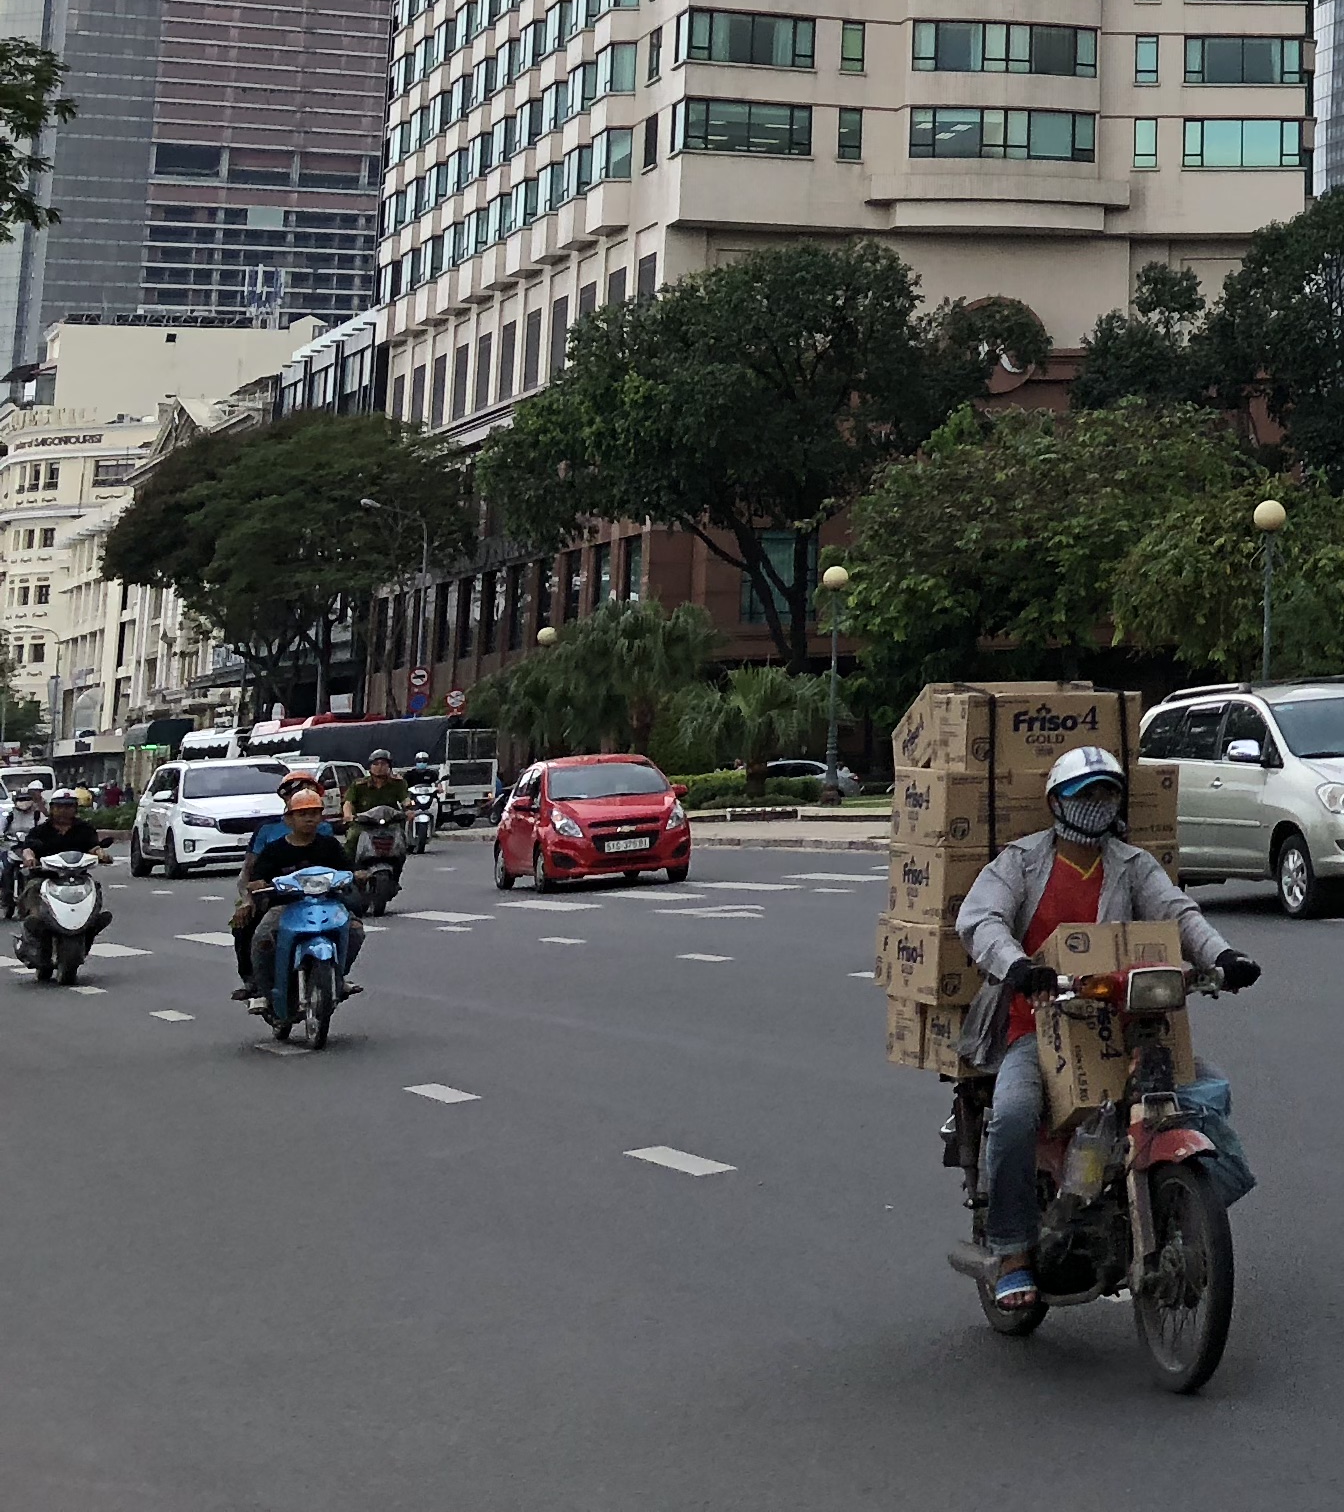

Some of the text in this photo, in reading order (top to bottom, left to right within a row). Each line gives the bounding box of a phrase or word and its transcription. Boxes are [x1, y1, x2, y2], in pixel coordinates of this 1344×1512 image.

[34, 434, 104, 447] SAIGONTOURIST
[1013, 703, 1099, 732] Friso 4
[1025, 734, 1065, 744] GOLD
